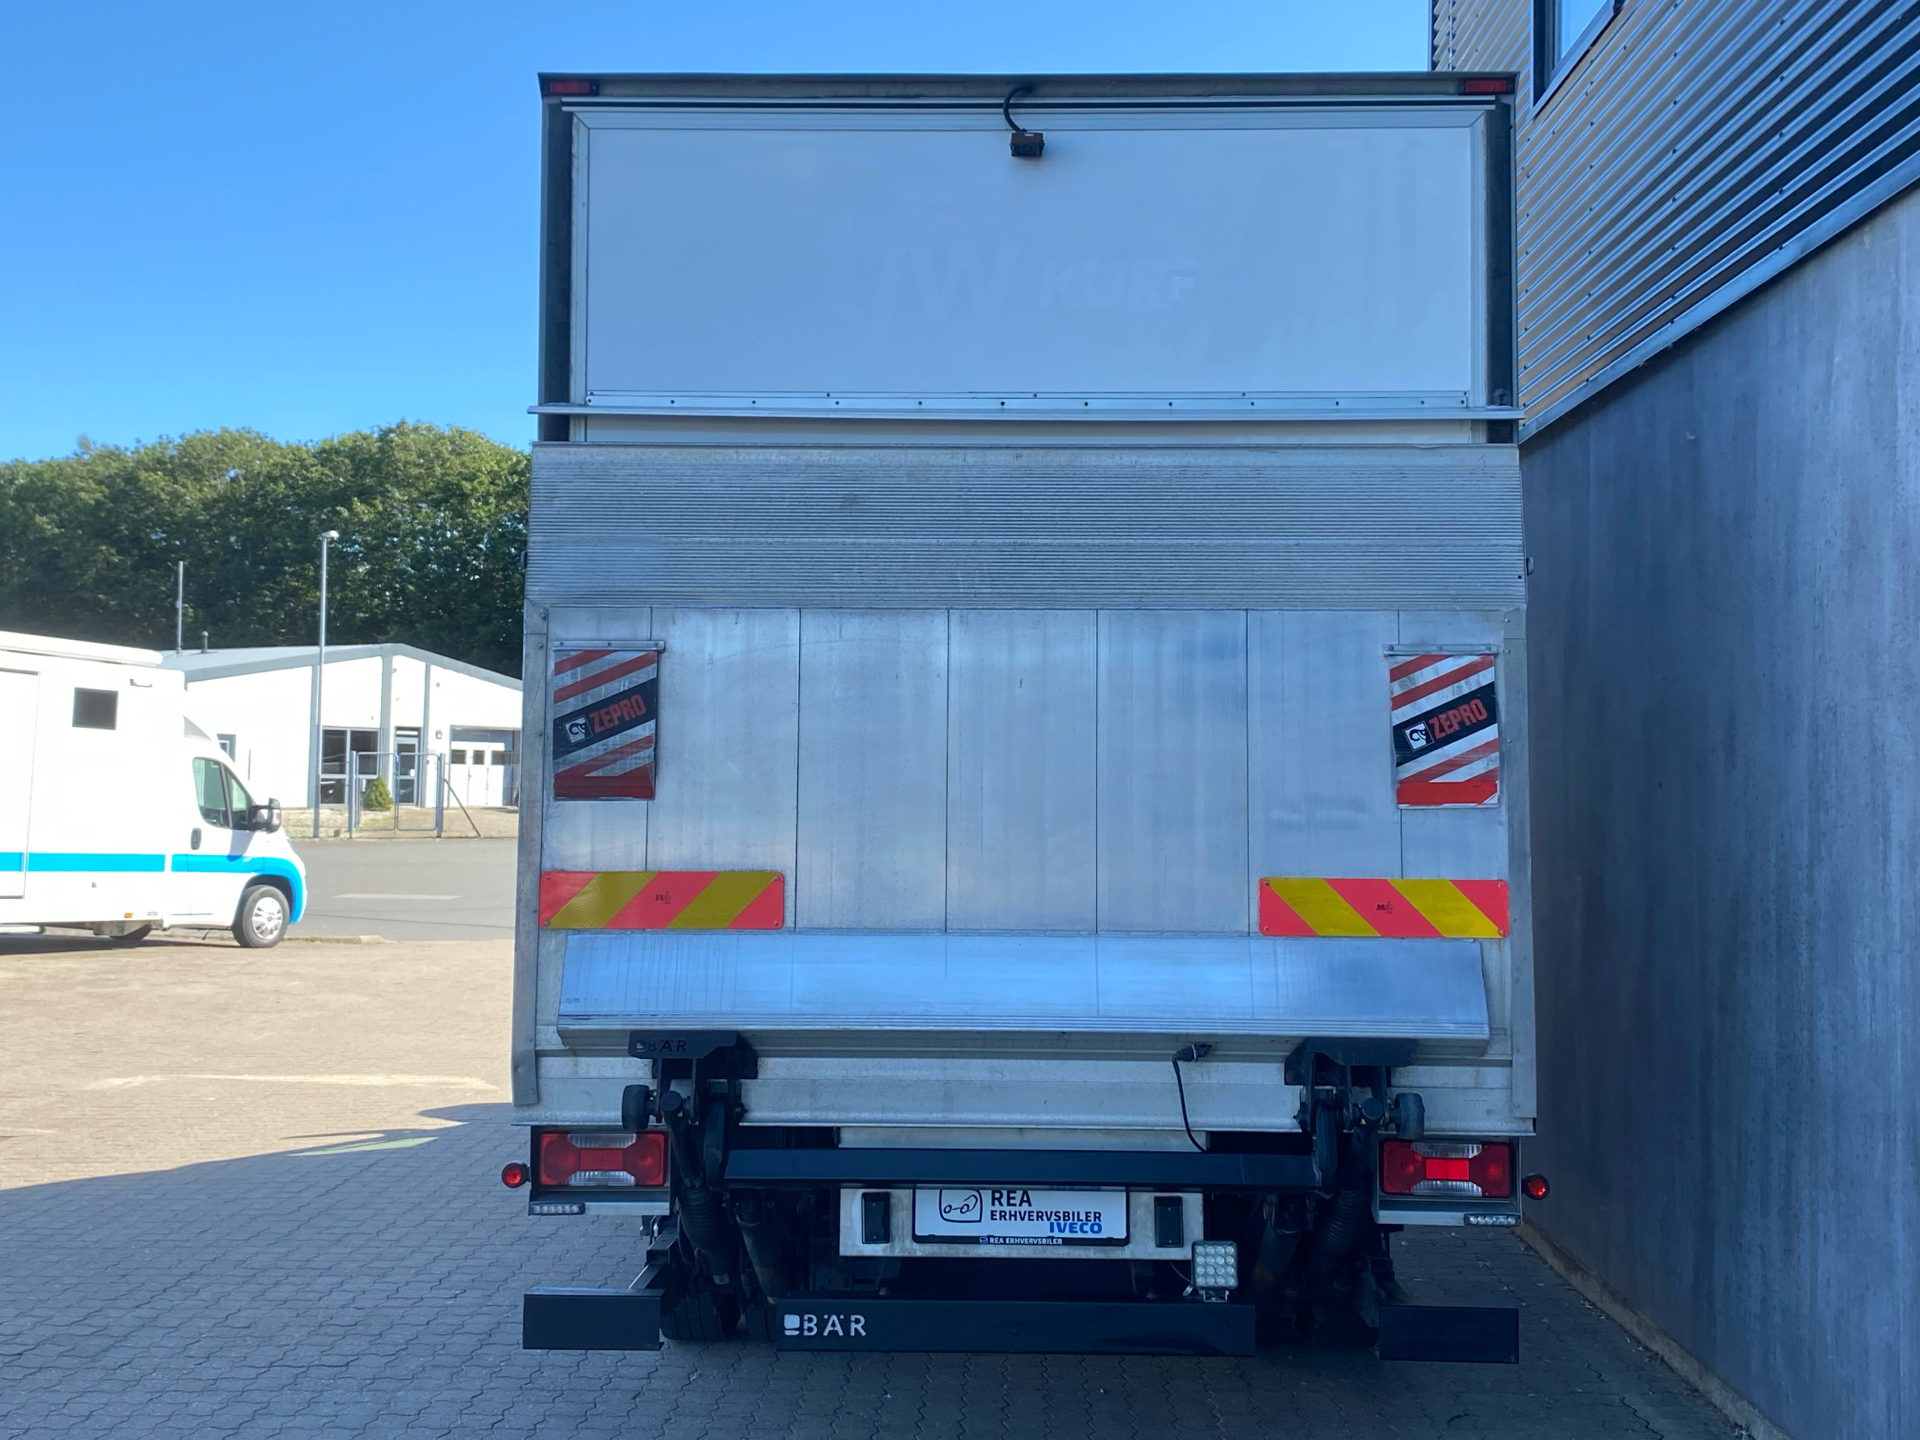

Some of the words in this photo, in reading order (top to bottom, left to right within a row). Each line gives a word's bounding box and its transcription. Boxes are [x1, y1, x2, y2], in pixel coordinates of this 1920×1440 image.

[589, 694, 647, 734] ZEPRO
[1428, 698, 1488, 740] ZEPRO
[990, 1189, 1033, 1207] REA
[990, 1210, 1102, 1223] ERHVERVSBILER
[1049, 1221, 1103, 1234] IVECO
[803, 1313, 867, 1337] BÄR
